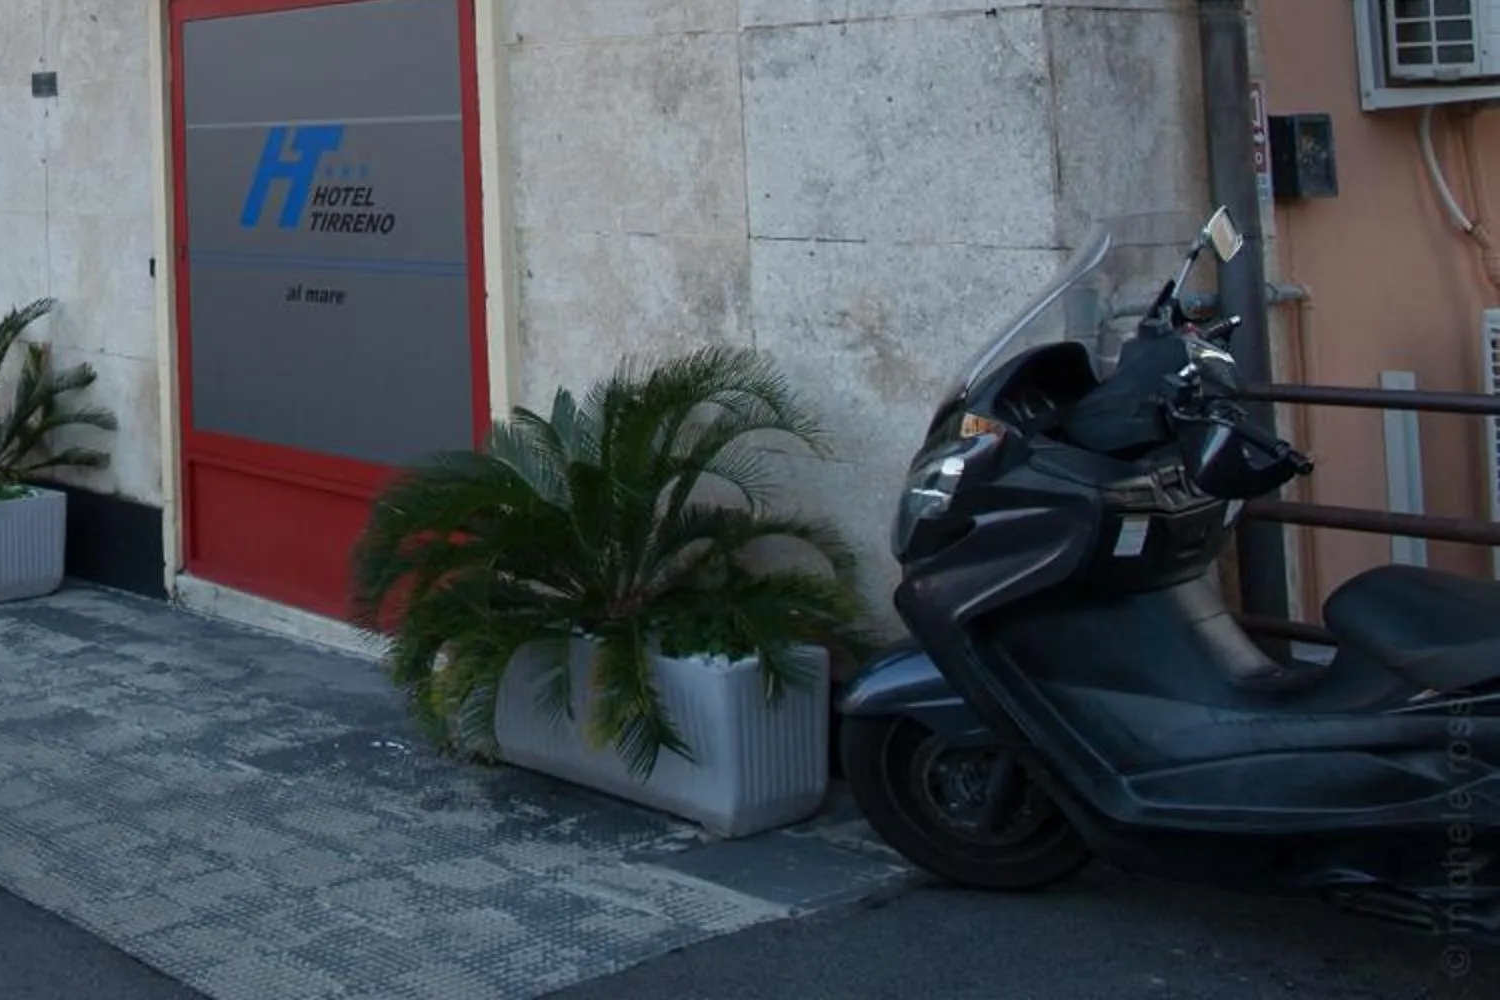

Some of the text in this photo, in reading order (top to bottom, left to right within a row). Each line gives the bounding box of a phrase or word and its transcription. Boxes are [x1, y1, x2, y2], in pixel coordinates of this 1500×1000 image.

[312, 186, 375, 208] HOTEL
[309, 211, 396, 236] TIRRENO
[285, 284, 348, 305] al mare
